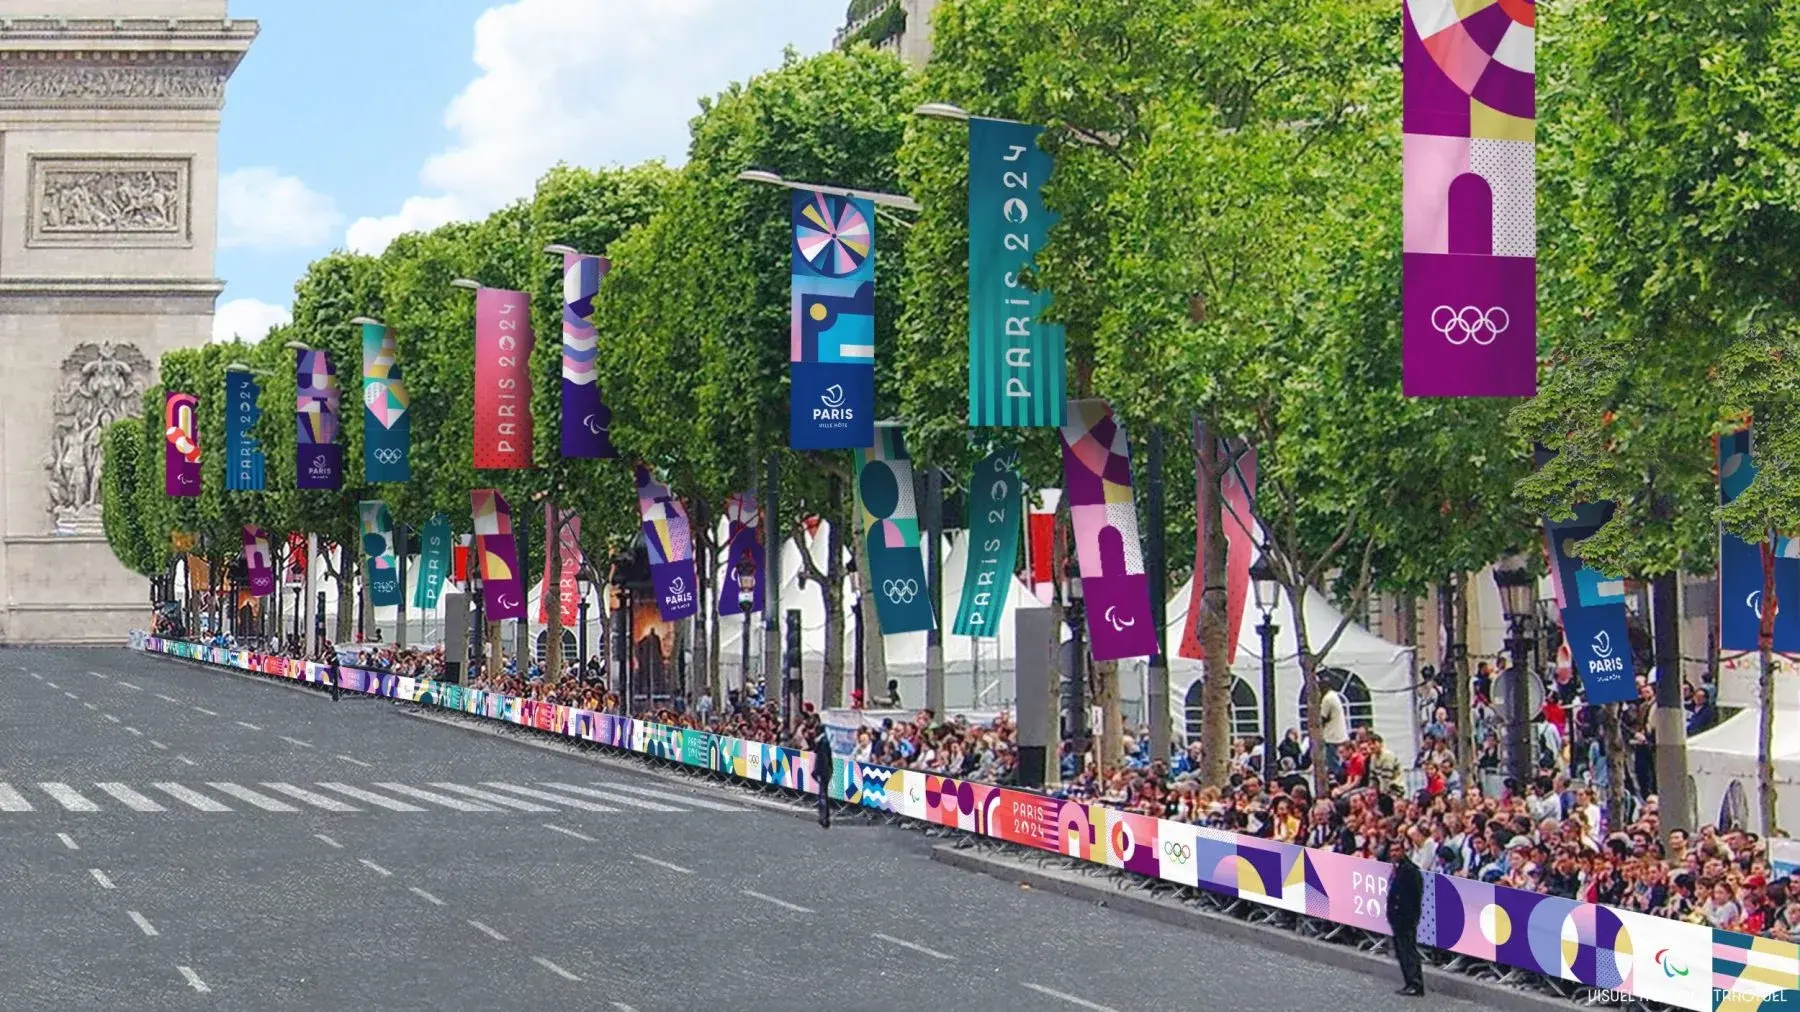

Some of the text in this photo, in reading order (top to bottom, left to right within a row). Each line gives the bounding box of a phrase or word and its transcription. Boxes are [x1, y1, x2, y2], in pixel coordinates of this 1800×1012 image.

[1003, 145, 1029, 250] 2024
[498, 304, 516, 367] 2024
[240, 381, 251, 423] 2024
[813, 408, 853, 420] PARIS
[308, 467, 331, 475] PARIS
[989, 451, 1018, 523] 202
[665, 592, 693, 605] PARIS
[1588, 657, 1623, 673] PARIS
[1014, 819, 1044, 839] 2024
[1353, 871, 1388, 896] PAR
[1354, 895, 1388, 920] 20
